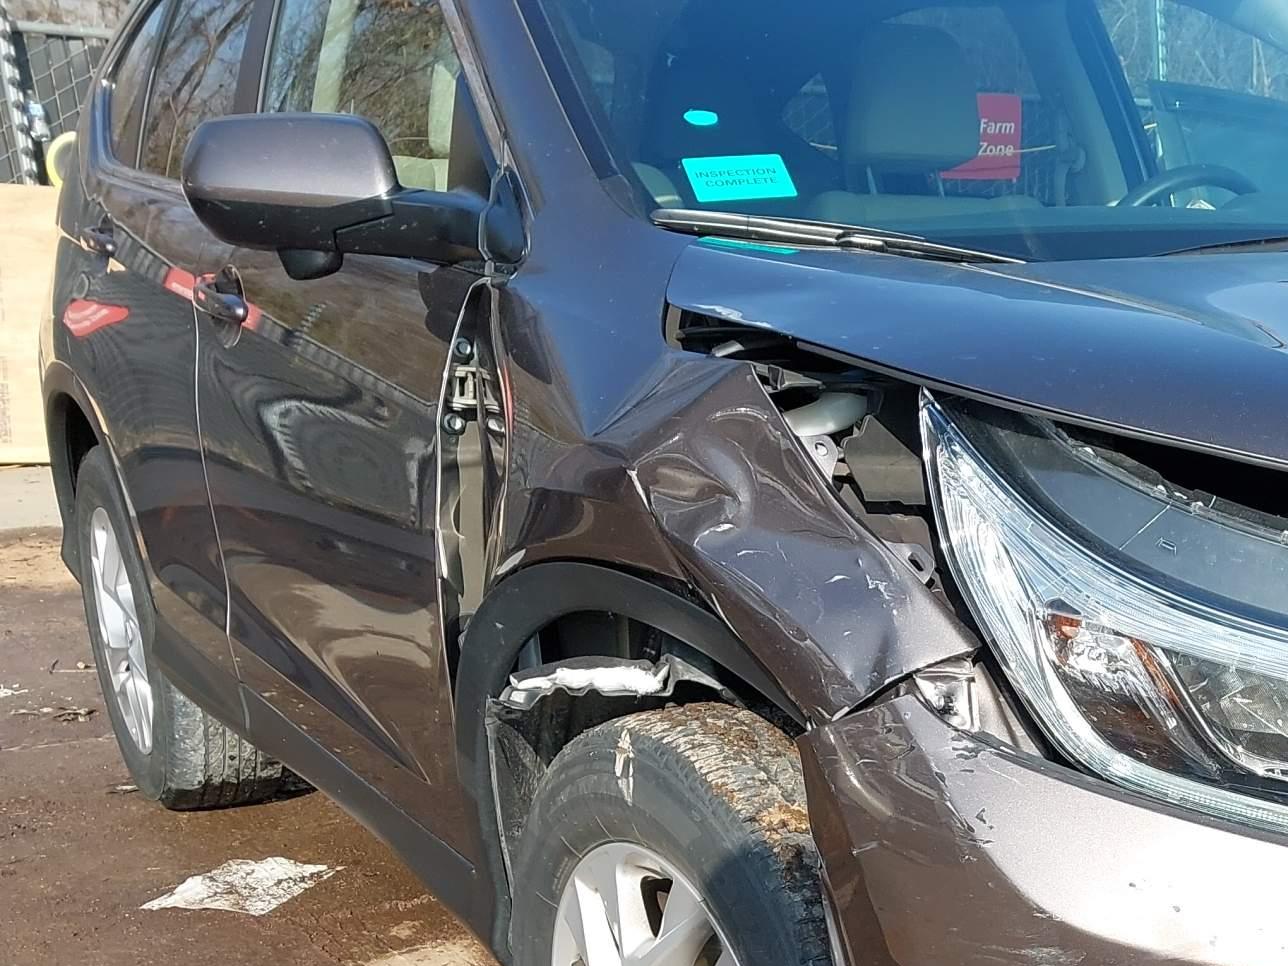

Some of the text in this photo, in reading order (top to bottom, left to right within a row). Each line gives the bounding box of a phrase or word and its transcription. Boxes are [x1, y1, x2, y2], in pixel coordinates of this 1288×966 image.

[980, 118, 1015, 134] Farm
[978, 142, 1014, 156] Zone
[695, 167, 776, 179] INSPECTION
[705, 177, 777, 188] COMPLETE
